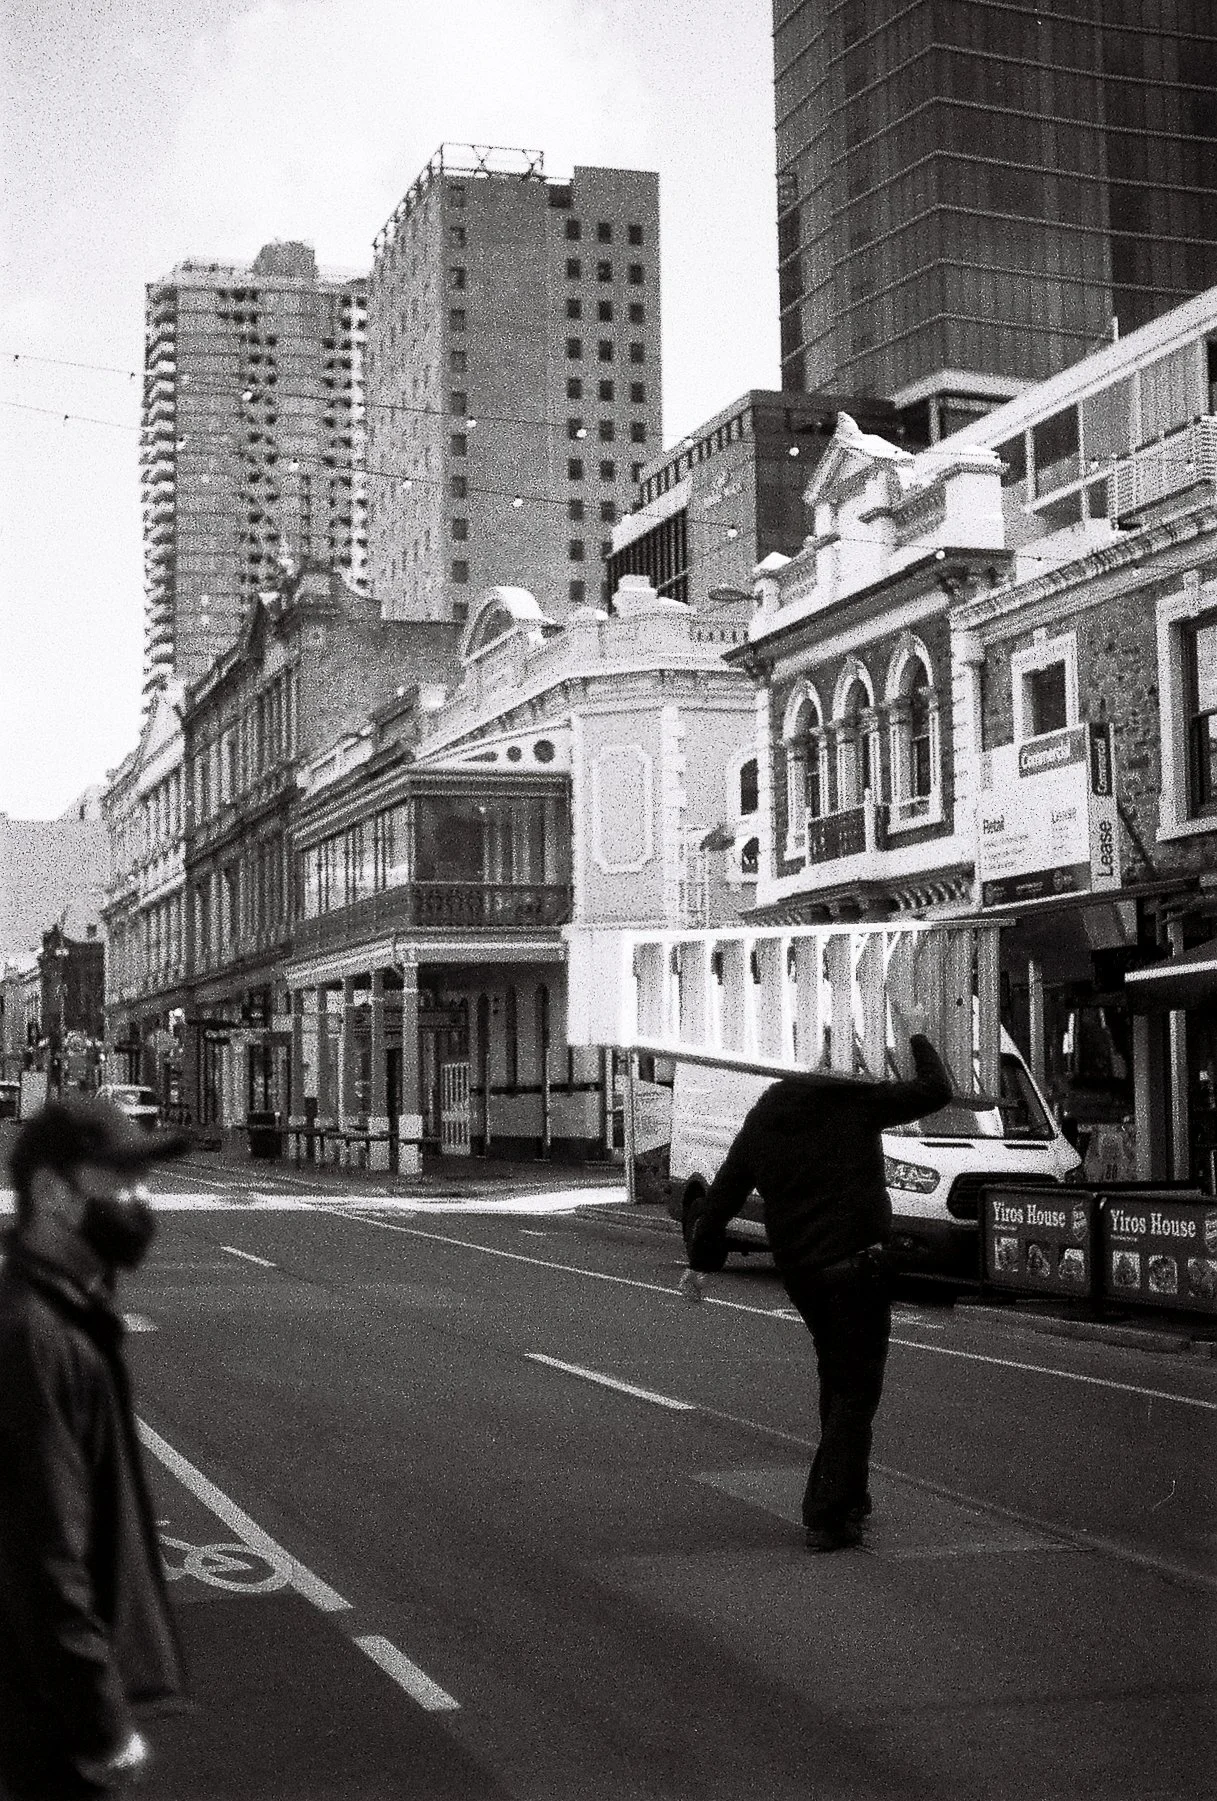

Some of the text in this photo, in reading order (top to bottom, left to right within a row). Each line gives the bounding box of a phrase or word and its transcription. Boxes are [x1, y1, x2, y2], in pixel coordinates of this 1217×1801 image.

[1098, 820, 1114, 878] Lease
[992, 1201, 1024, 1224] Yiros
[1027, 1204, 1066, 1228] House
[1110, 1209, 1146, 1235] Yiros
[1150, 1213, 1197, 1238] House
